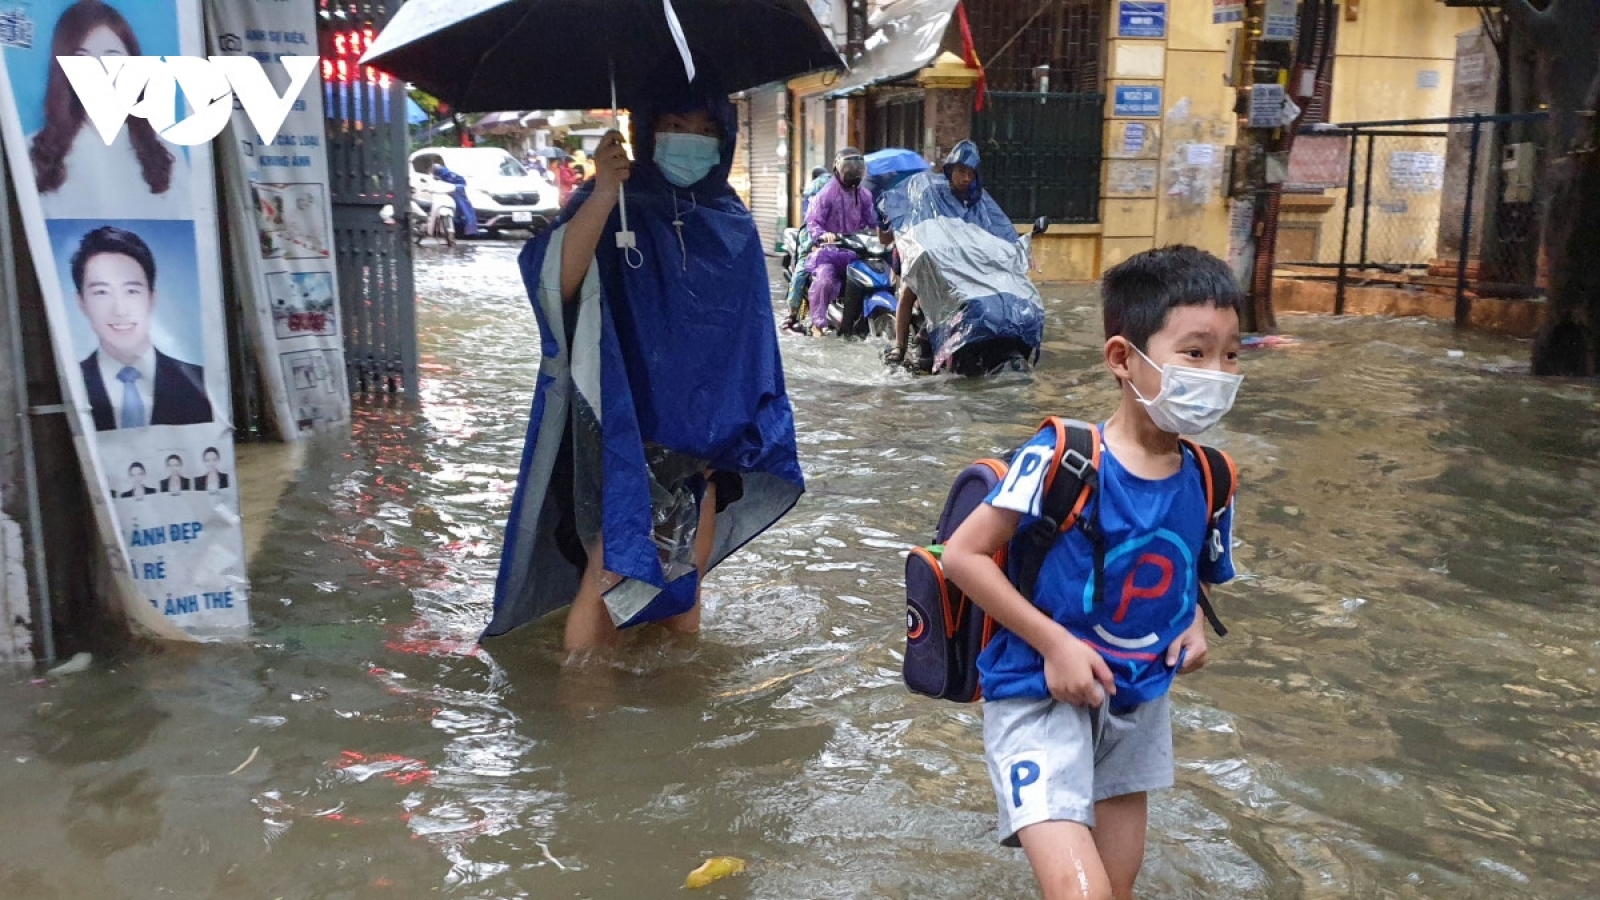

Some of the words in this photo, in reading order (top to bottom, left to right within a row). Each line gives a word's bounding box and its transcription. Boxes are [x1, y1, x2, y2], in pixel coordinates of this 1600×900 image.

[1009, 453, 1041, 491] P
[170, 522, 203, 544] ĐẸP
[143, 557, 166, 579] RẺ
[1113, 553, 1174, 622] P
[1010, 760, 1040, 808] P
